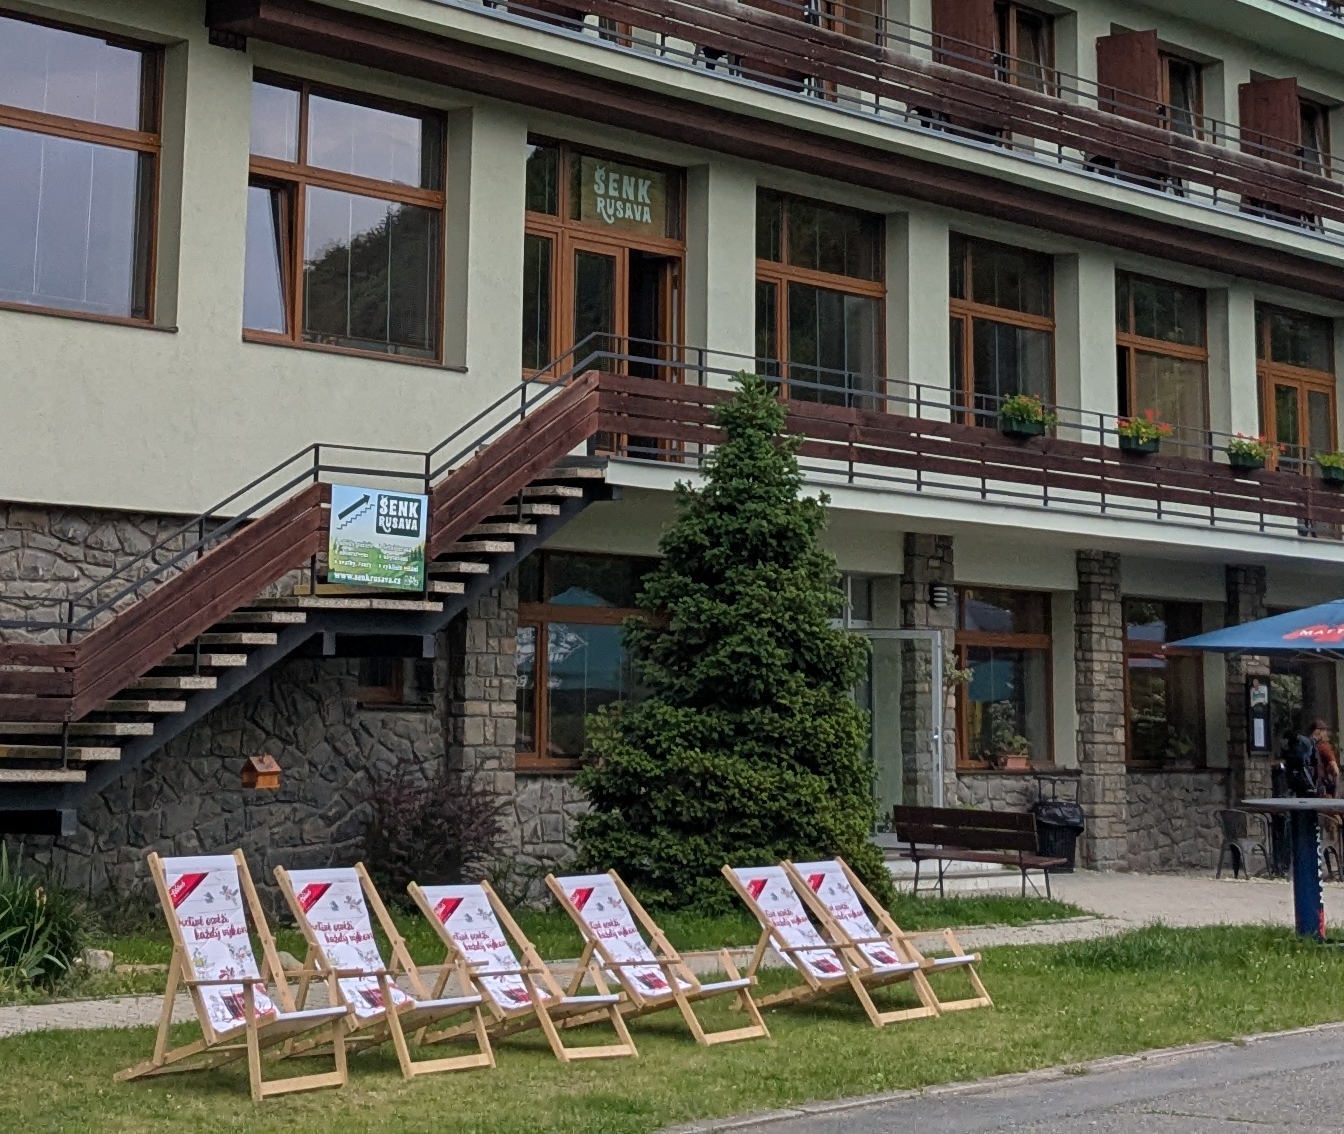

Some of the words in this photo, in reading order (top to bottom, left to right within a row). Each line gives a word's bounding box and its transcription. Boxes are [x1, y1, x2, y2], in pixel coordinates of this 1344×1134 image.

[594, 165, 651, 204] ŠENK
[596, 197, 652, 224] RUSAVA
[379, 496, 419, 518] ŠENK
[378, 516, 418, 533] RUSAVA
